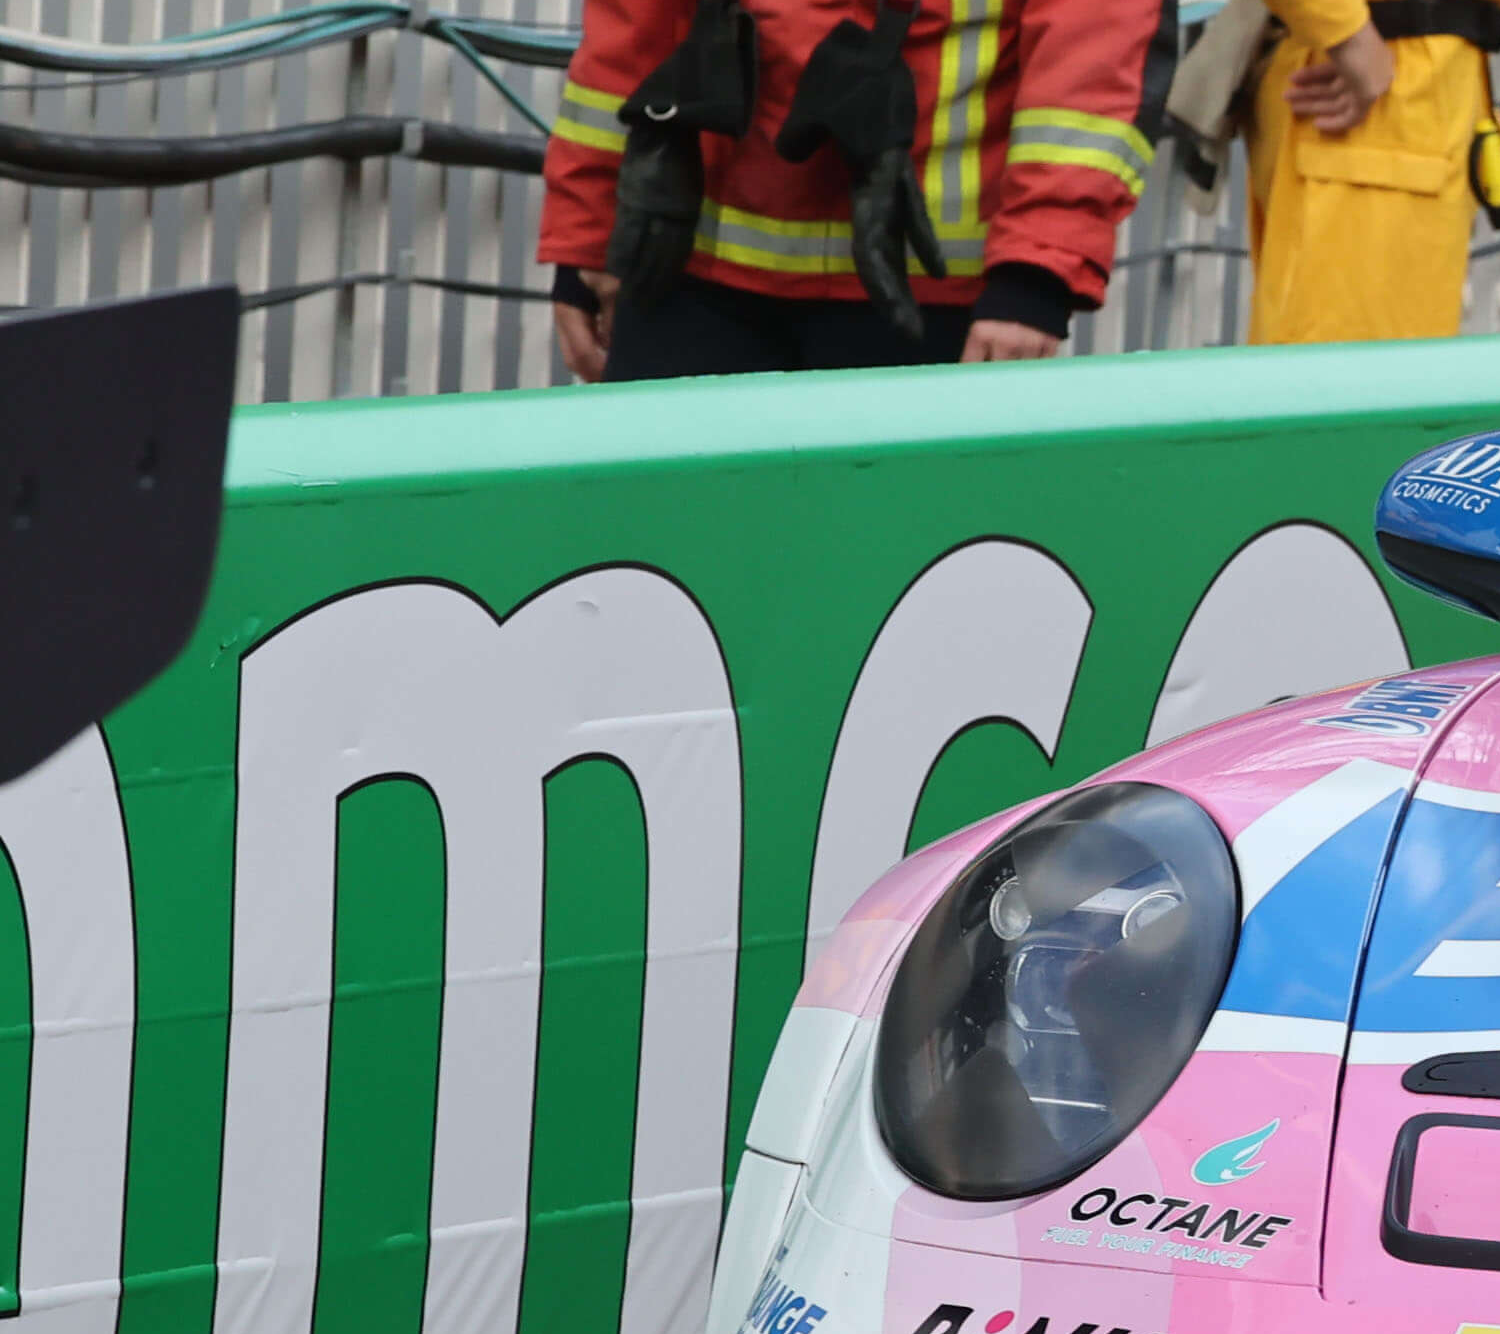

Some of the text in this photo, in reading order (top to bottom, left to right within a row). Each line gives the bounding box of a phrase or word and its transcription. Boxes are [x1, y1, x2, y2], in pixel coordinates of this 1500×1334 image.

[1391, 480, 1493, 514] COSMETICS
[1067, 1187, 1292, 1251] OCTANE
[1041, 1226, 1254, 1269] FUEL YOUR FINANCE
